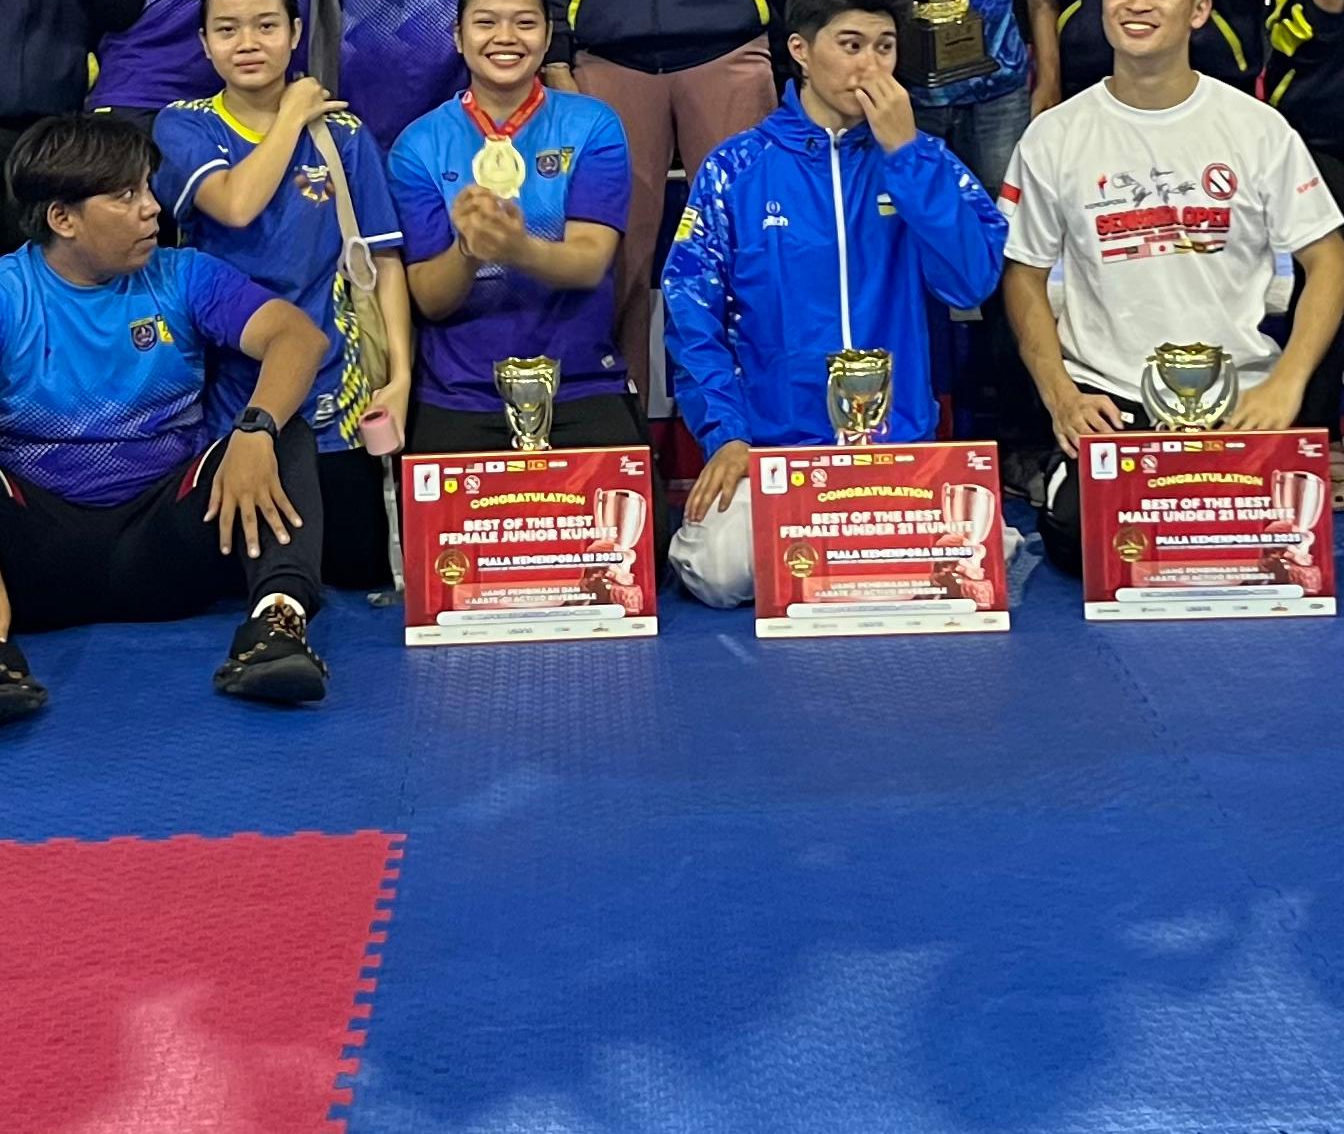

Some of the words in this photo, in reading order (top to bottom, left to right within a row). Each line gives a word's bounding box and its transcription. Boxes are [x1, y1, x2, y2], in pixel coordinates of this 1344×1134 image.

[1147, 472, 1264, 488] CONGRATULATION
[470, 492, 586, 509] CONGRATULATION
[817, 486, 933, 502] CONGRATULATION
[1141, 498, 1178, 511] BEST
[1179, 498, 1202, 510] OF
[1203, 497, 1232, 509] THE
[1234, 496, 1272, 509] BEST
[463, 518, 500, 532] BEST
[502, 518, 524, 531] OF
[526, 517, 554, 529] THE
[556, 515, 594, 528] BEST
[811, 512, 848, 525] BEST
[850, 511, 871, 524] OF
[873, 510, 903, 523] THE
[904, 509, 942, 521] BEST
[1118, 510, 1160, 524] MALE
[1162, 509, 1216, 522] UNDER
[1218, 509, 1235, 521] 21
[1237, 507, 1296, 521] KUMITE
[439, 531, 499, 546] FEMALE
[501, 529, 557, 542] JUNIOR
[560, 526, 618, 540] KUMITE
[780, 525, 840, 538] FEMALE
[841, 523, 895, 536] UNDER
[897, 522, 914, 535] 21
[916, 521, 974, 534] KUMITE
[477, 555, 511, 566] PIALA
